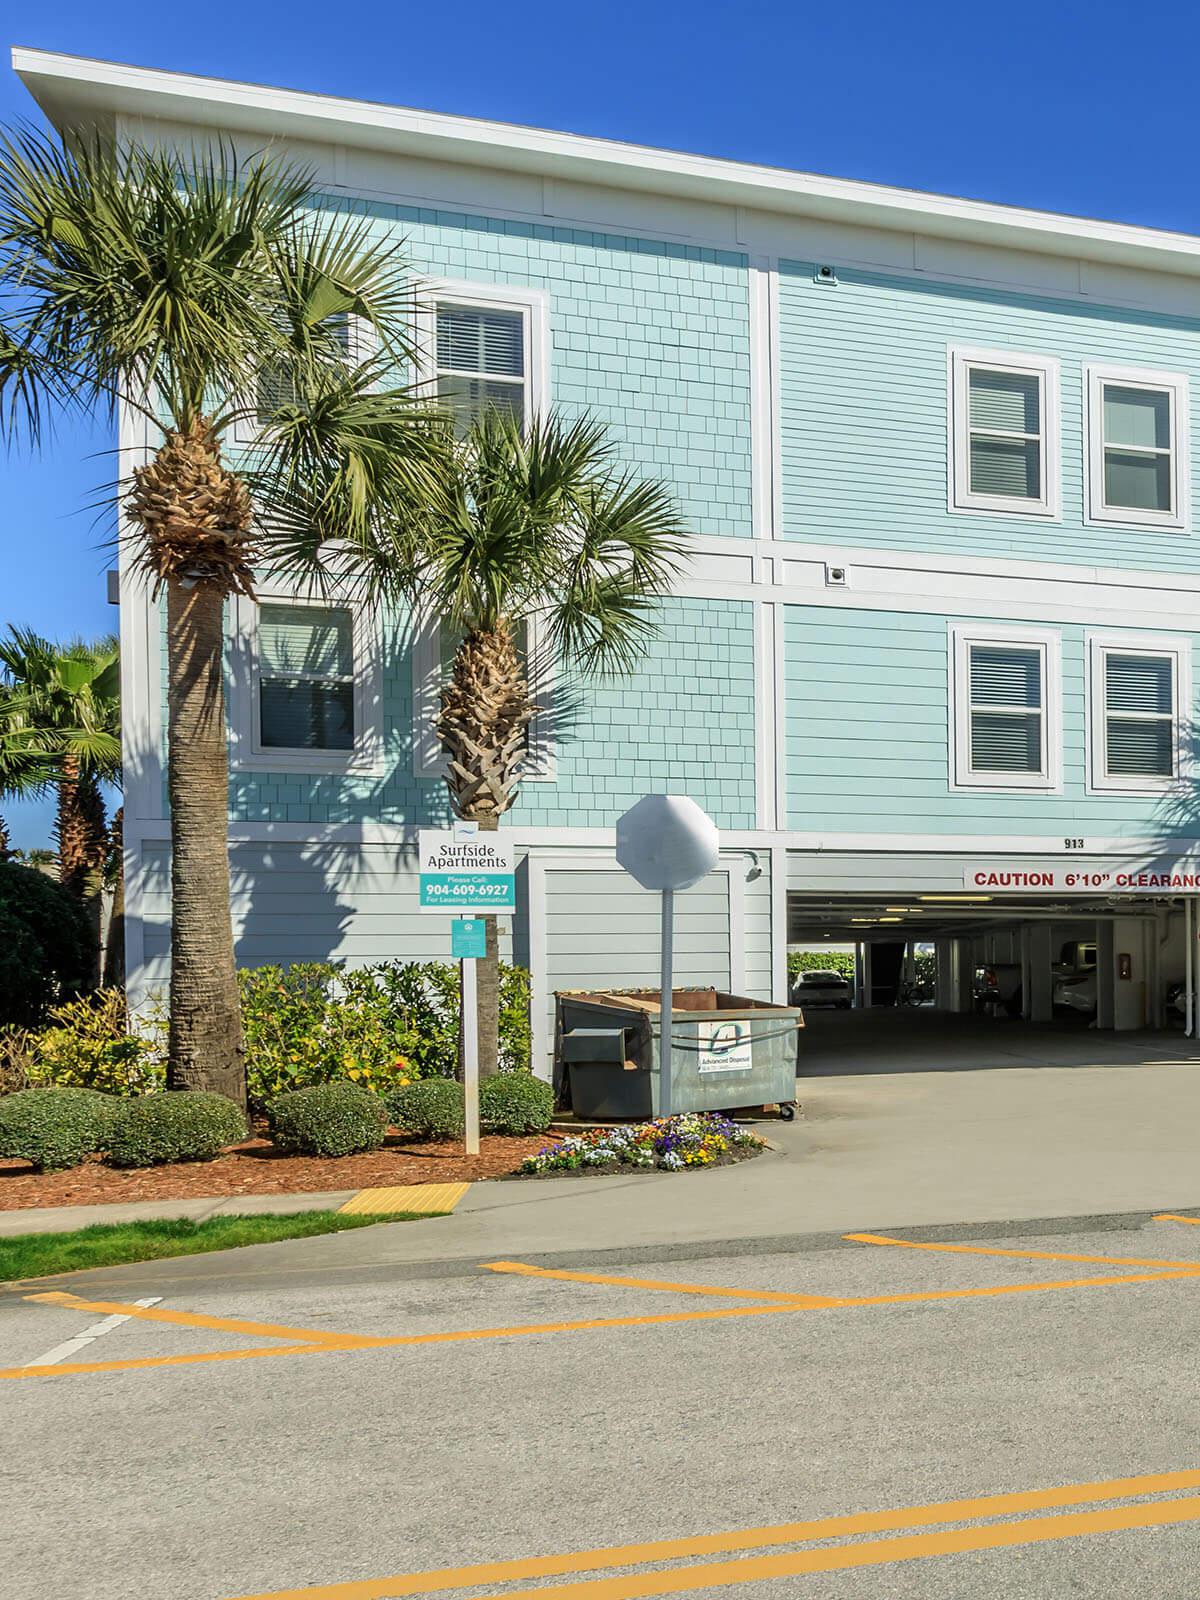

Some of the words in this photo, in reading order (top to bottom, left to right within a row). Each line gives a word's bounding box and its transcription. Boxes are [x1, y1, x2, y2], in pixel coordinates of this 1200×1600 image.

[1064, 838, 1084, 849] 913
[440, 845, 495, 856] Surfside
[428, 856, 506, 869] Apartments
[974, 872, 1054, 886] CAUTION
[426, 885, 508, 895] 904-609-6927
